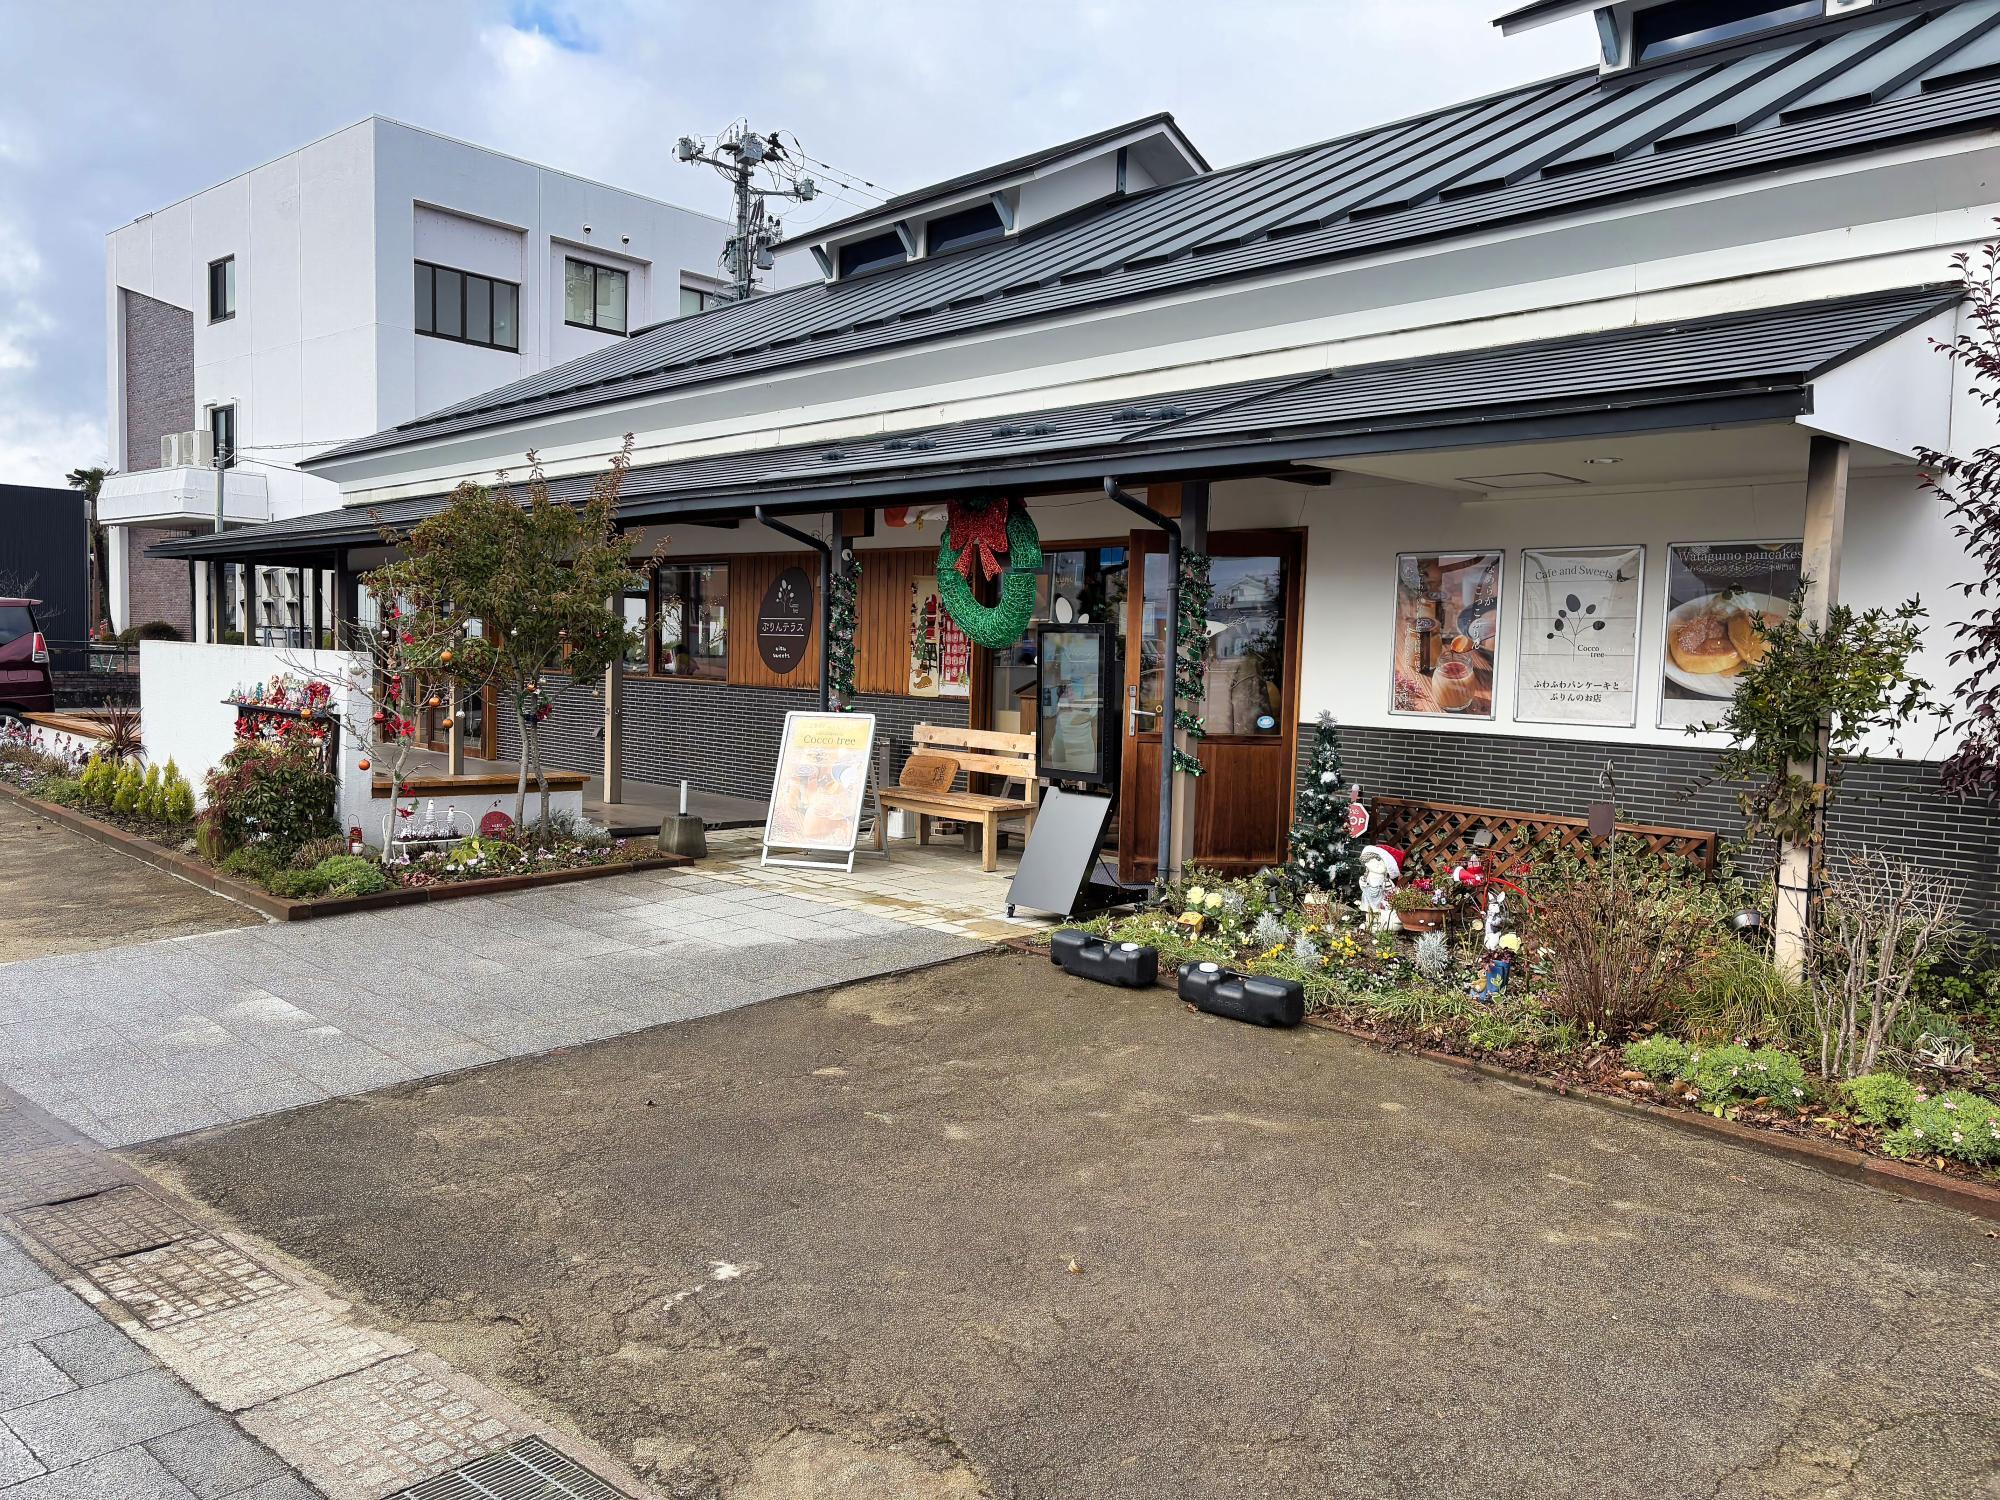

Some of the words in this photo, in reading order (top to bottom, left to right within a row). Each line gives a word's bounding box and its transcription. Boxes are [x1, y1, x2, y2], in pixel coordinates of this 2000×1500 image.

[1745, 549, 1803, 561] pancakes
[1535, 568, 1557, 580] Cafe
[1559, 565, 1577, 576] and
[1578, 565, 1614, 579] Sweets
[761, 622, 804, 633] ぷりんテラス
[1577, 644, 1600, 652] Cocco
[1533, 680, 1620, 691] ふわふわパンケーキと
[803, 734, 834, 745] Cocco
[836, 736, 857, 746] tree
